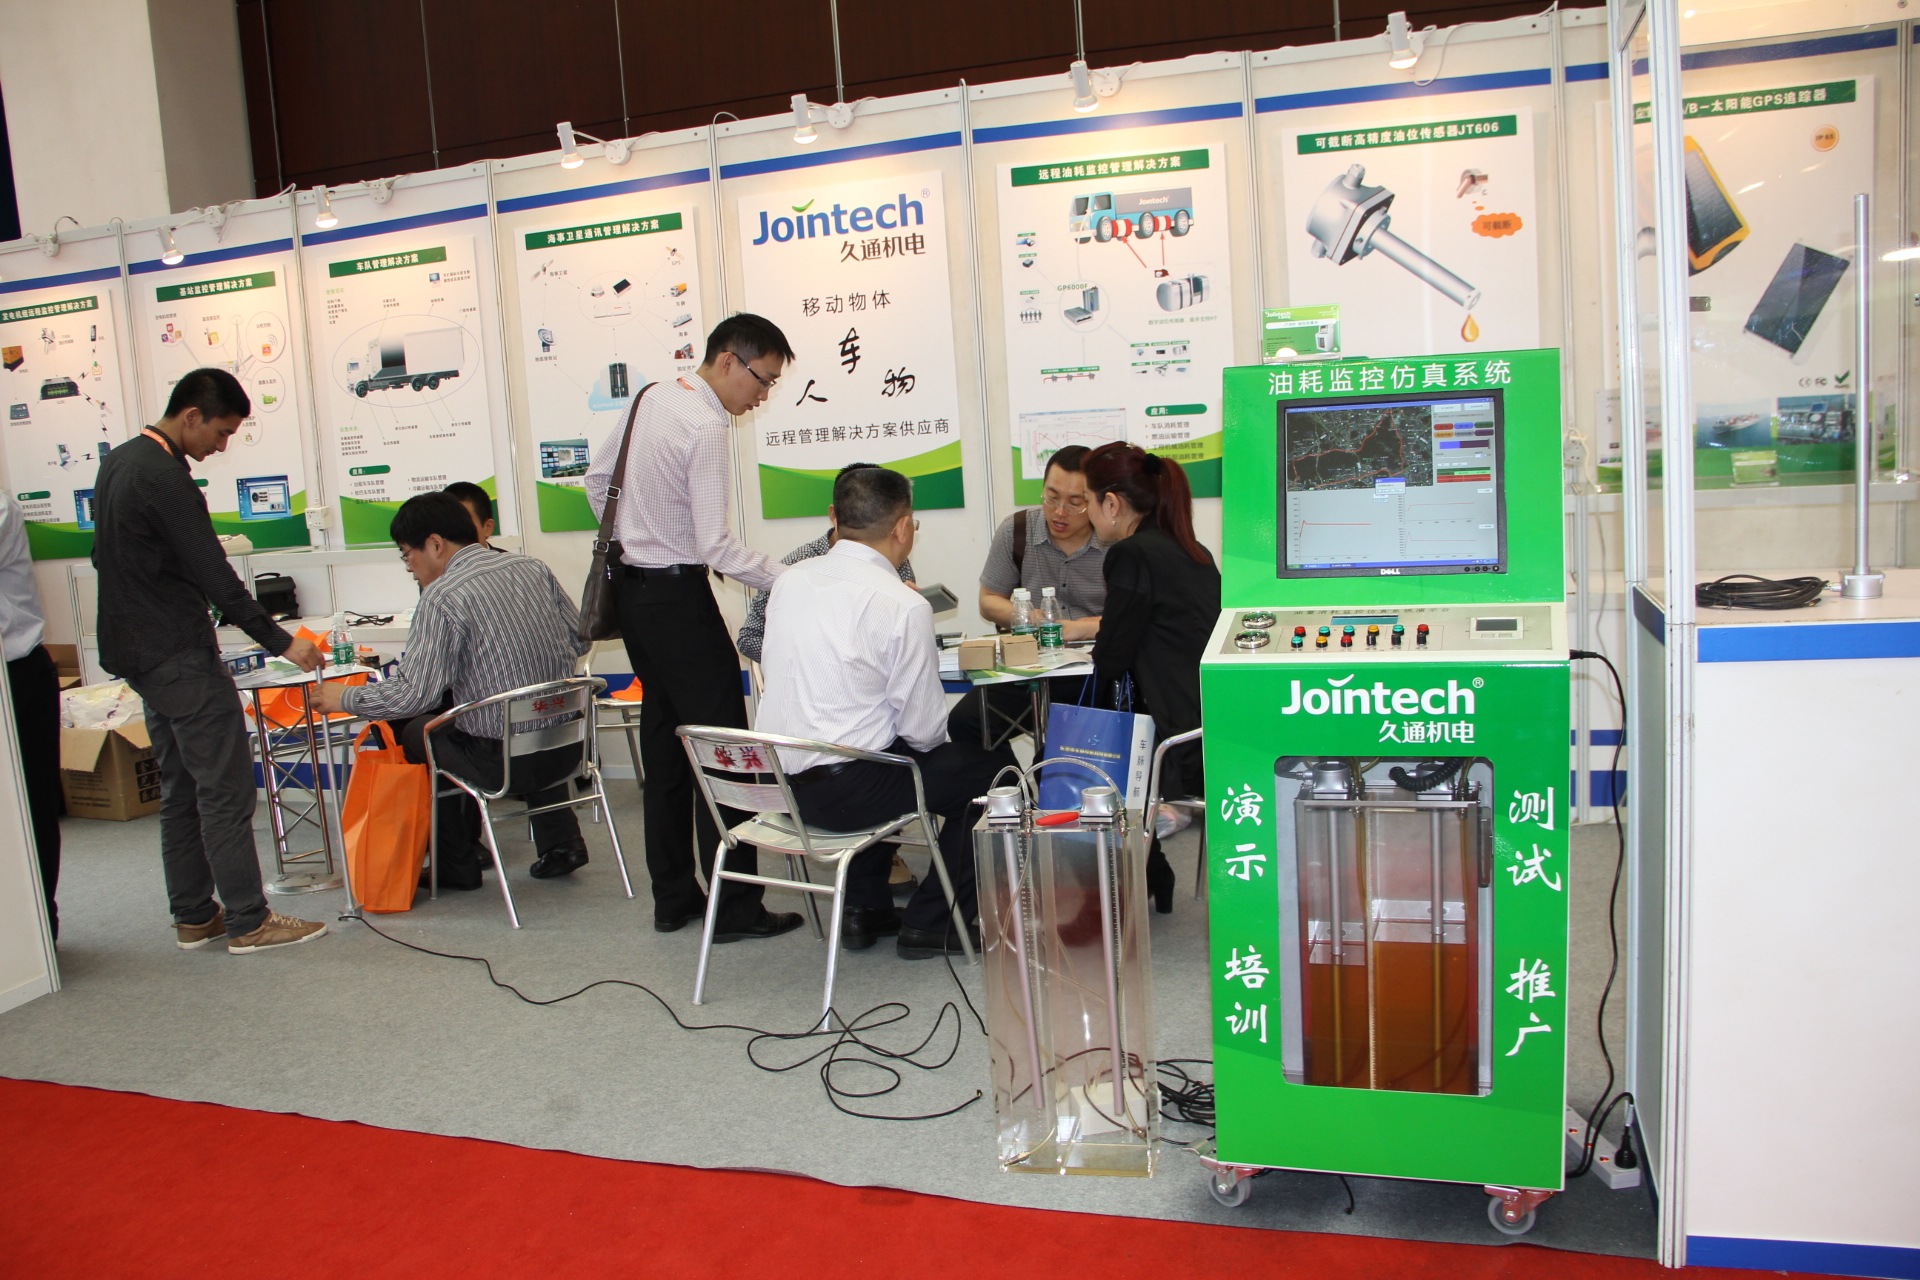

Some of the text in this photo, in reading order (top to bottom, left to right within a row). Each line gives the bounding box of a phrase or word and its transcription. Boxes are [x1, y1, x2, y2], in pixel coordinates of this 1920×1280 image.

[1315, 121, 1500, 149] 可截断高精度油位传感器JT606
[1038, 155, 1182, 181] 远程油耗监控管理解决方案
[1138, 196, 1168, 206] Jointech
[547, 219, 660, 244] 海事卫星通讯管理解决方案
[752, 193, 925, 246] Jointech
[1482, 220, 1512, 231] 可截断
[840, 232, 926, 263] 久通机电
[356, 253, 420, 272] 车队管理解决方案
[179, 278, 253, 297] 基站监控管理解决方案
[1057, 283, 1089, 292] GP6000F
[1, 299, 94, 321] 发电机组远程监控管理解决方案
[802, 289, 891, 318] 移动物体
[838, 327, 861, 374] 车
[881, 366, 916, 398] 物
[1267, 359, 1512, 396] 油耗监控仿真系统
[796, 379, 828, 407] 人
[765, 417, 950, 447] 远程管理解决方案供应商
[1293, 607, 1451, 616] 油量消耗监控仿真系统演示台
[531, 696, 566, 714] 华兴
[1281, 675, 1475, 715] Jointech
[1378, 720, 1476, 744] 久通机电
[1221, 783, 1266, 881] 演示
[1507, 787, 1562, 891] 测试
[1224, 945, 1269, 1043] 培训
[1505, 958, 1555, 1057] 推广
